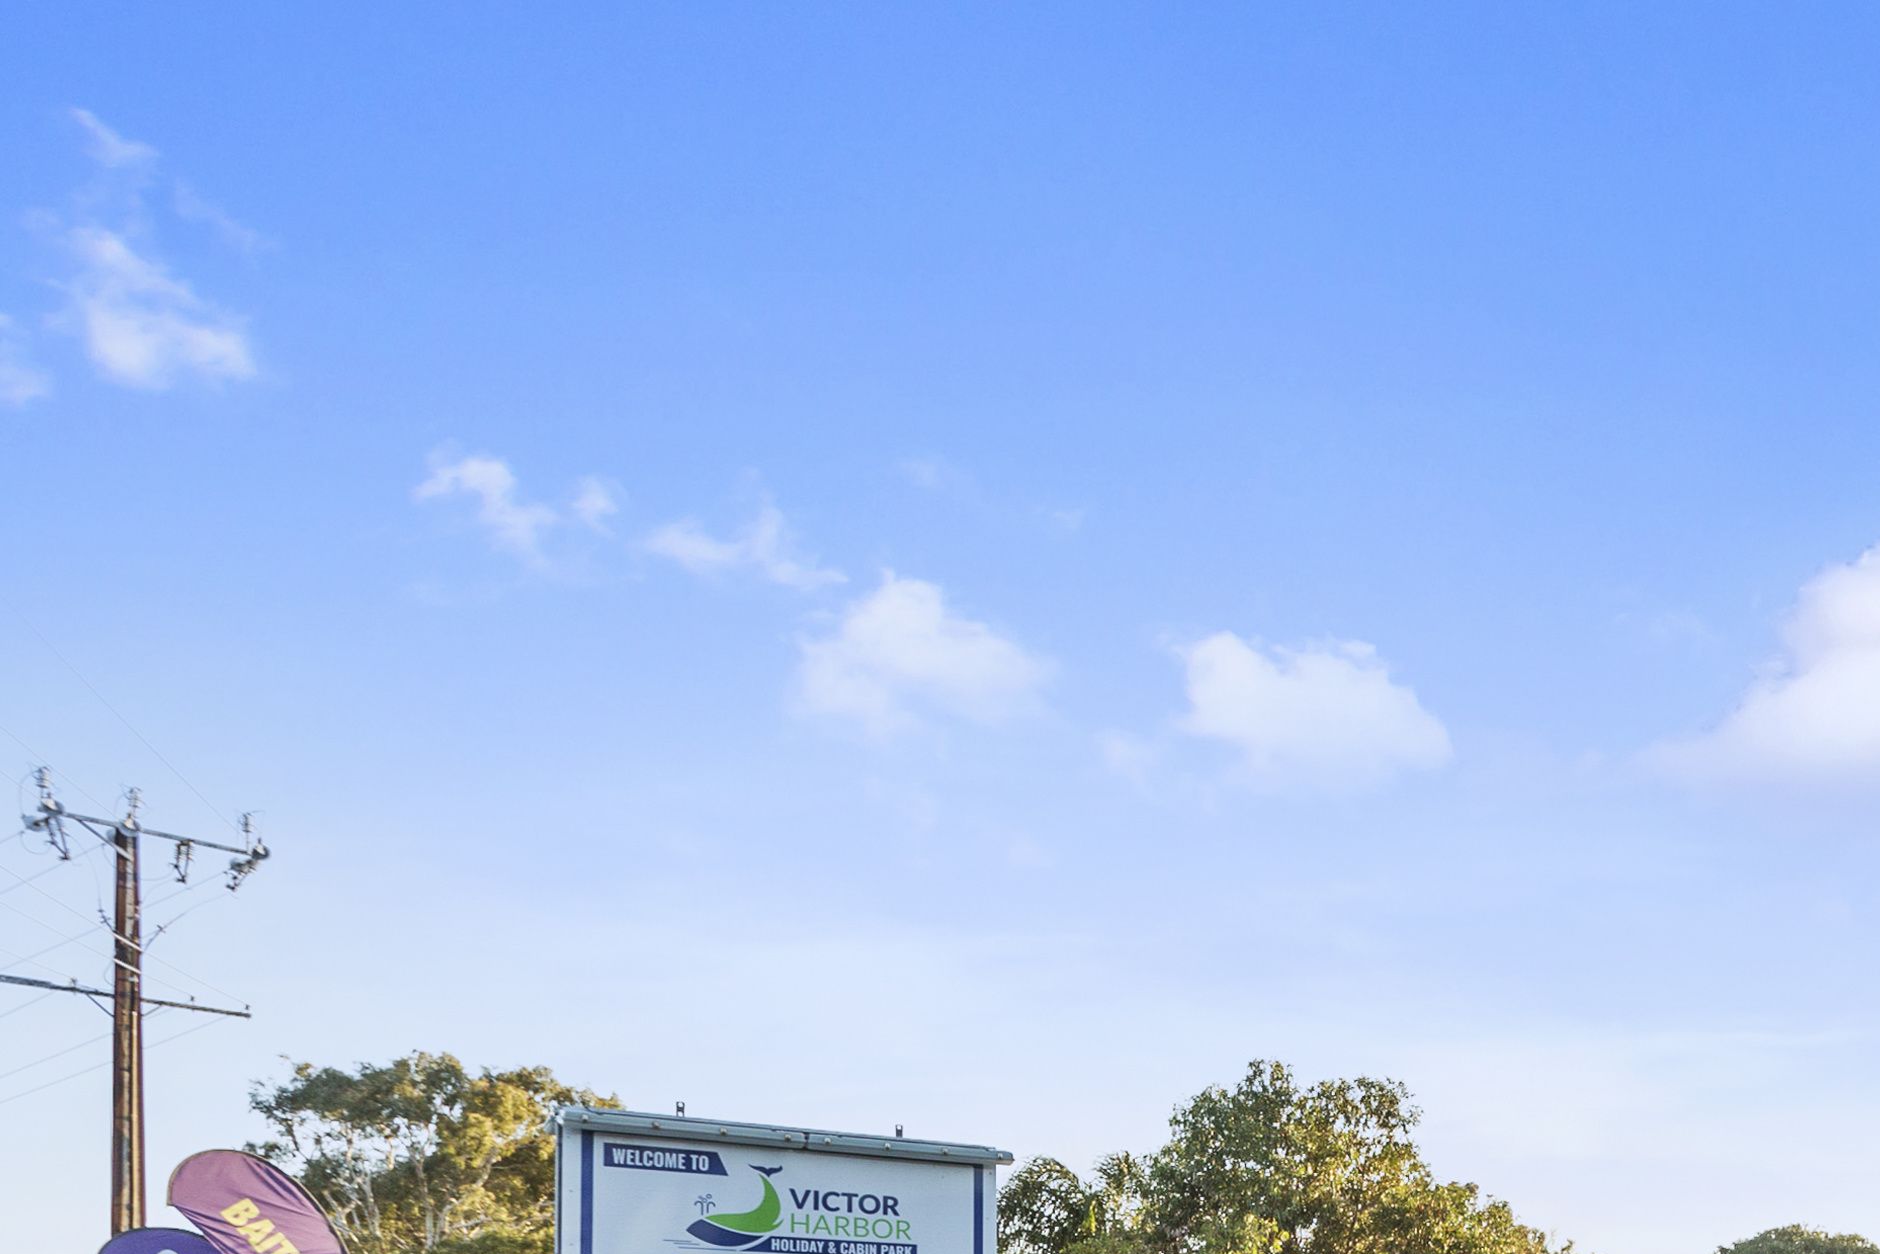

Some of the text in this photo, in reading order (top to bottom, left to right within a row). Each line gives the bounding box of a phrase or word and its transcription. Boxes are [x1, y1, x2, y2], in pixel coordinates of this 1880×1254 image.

[612, 1148, 709, 1171] WELCOME TO
[789, 1187, 900, 1217] VICTOR
[789, 1213, 912, 1241] HARBOR
[771, 1238, 825, 1254] HOLIDAY
[827, 1241, 838, 1254] &
